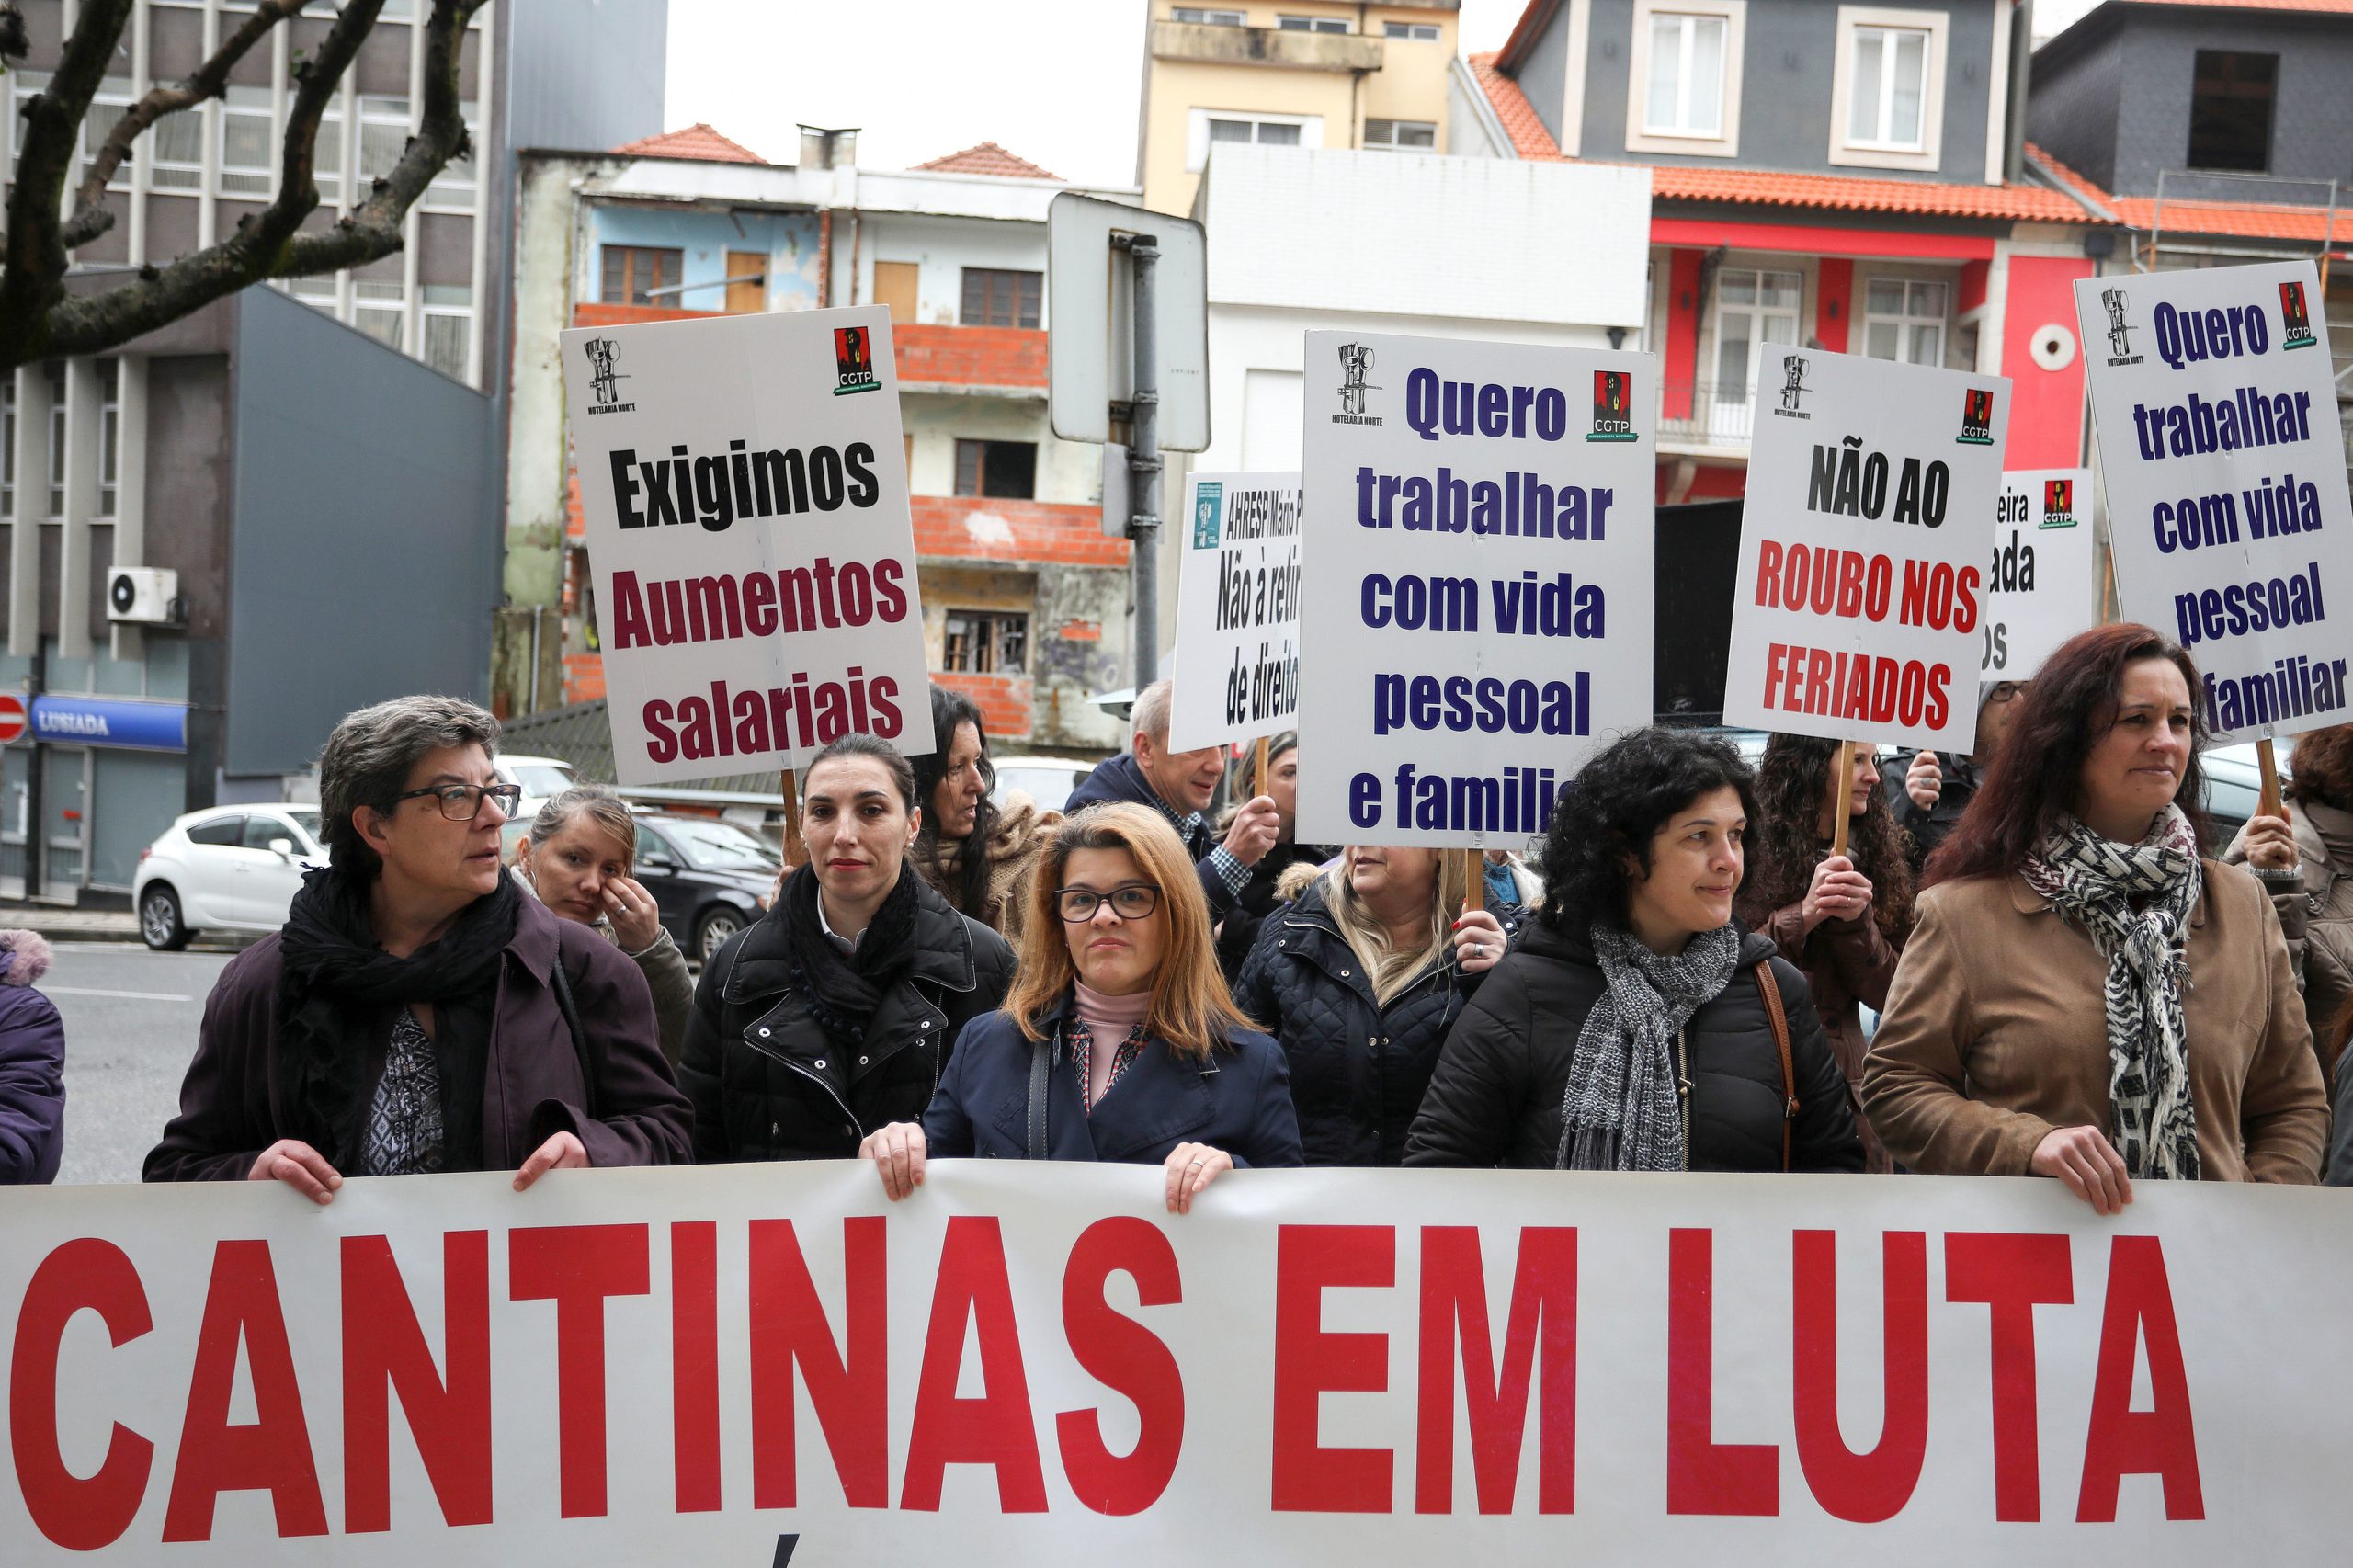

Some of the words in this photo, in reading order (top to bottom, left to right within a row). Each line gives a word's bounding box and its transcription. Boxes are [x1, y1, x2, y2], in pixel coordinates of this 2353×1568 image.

[2154, 302, 2269, 370] Quero
[2286, 326, 2309, 339] CGTP
[587, 404, 617, 415] HOTELARIA
[618, 403, 636, 413] NORTE
[839, 371, 872, 385] CGTP
[1406, 367, 1567, 441] Quero
[1332, 414, 1363, 426] HOTELARIA
[1364, 416, 1382, 426] NORTE
[1595, 419, 1629, 433] CGTP
[1962, 426, 1988, 438] CGTP
[2132, 386, 2311, 461] trabalhar
[608, 439, 880, 531] Exigimos
[1356, 467, 1613, 541] trabalhar
[1807, 435, 1889, 520] NÃO
[1893, 458, 1950, 528] AO
[2044, 513, 2072, 523] CGTP
[2152, 492, 2240, 554] com
[2242, 473, 2323, 540] vida
[612, 557, 907, 650] Aumentos
[1216, 550, 1251, 631] Não
[1255, 546, 1266, 627] à
[1360, 574, 1479, 633] com
[1491, 570, 1606, 639] vida
[1755, 540, 1893, 622] ROUBO
[1899, 560, 1980, 634] NOS
[2175, 562, 2325, 649] pessoal
[642, 666, 904, 763] salariais
[1227, 646, 1247, 726] de
[1373, 672, 1591, 737] pessoal
[1764, 644, 1951, 731] FERIADOS
[2203, 654, 2347, 725] familiar
[1348, 773, 1381, 829] e
[1394, 764, 1575, 834] famili
[9, 1215, 1186, 1551] CANTINAS
[1271, 1224, 1578, 1515] EM
[1666, 1227, 2206, 1524] LUTA
